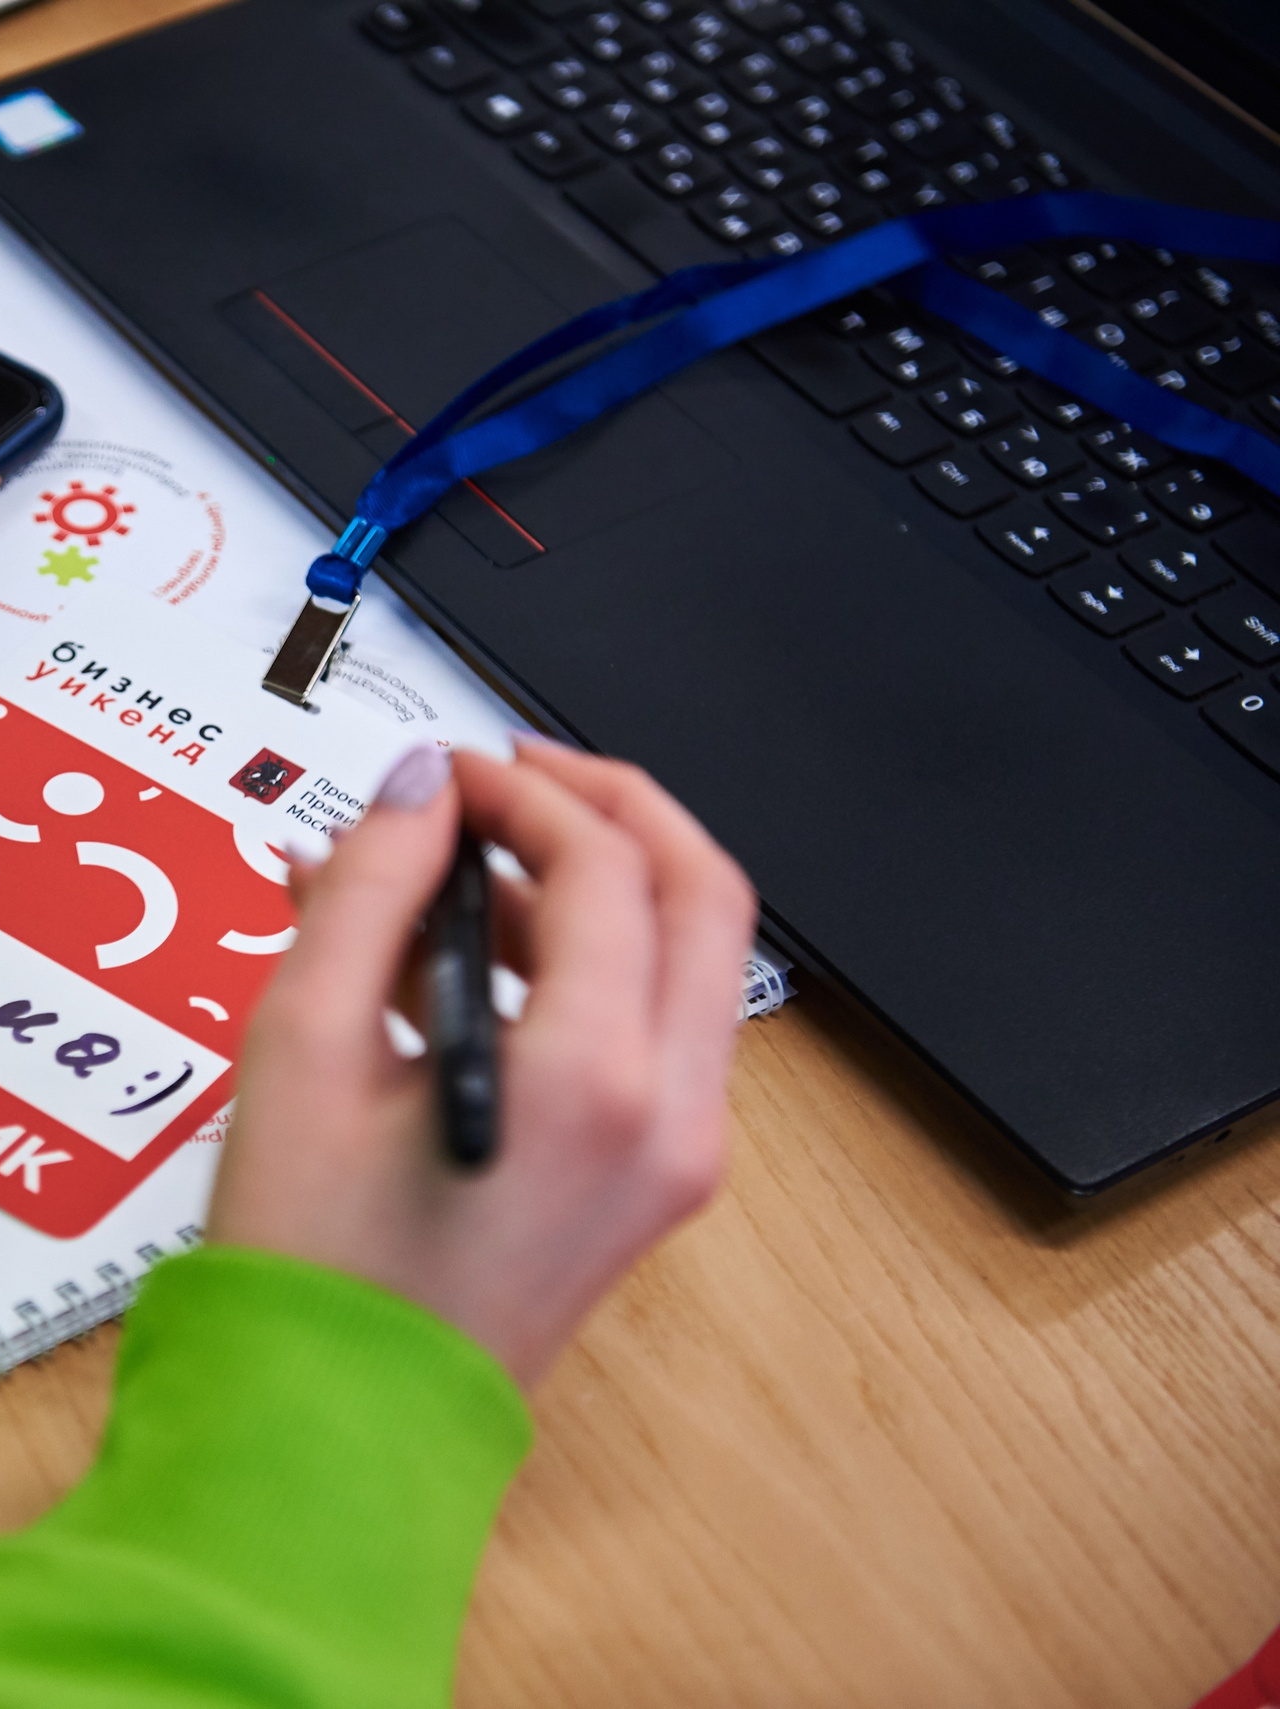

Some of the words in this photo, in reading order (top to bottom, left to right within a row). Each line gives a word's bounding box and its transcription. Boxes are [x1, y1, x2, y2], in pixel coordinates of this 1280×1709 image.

[26, 661, 207, 766] уикенд
[52, 641, 223, 741] бизнес
[340, 653, 439, 722] высокотехно
[286, 804, 337, 838] Моск
[300, 790, 358, 828] Прави
[313, 777, 370, 813] Проек
